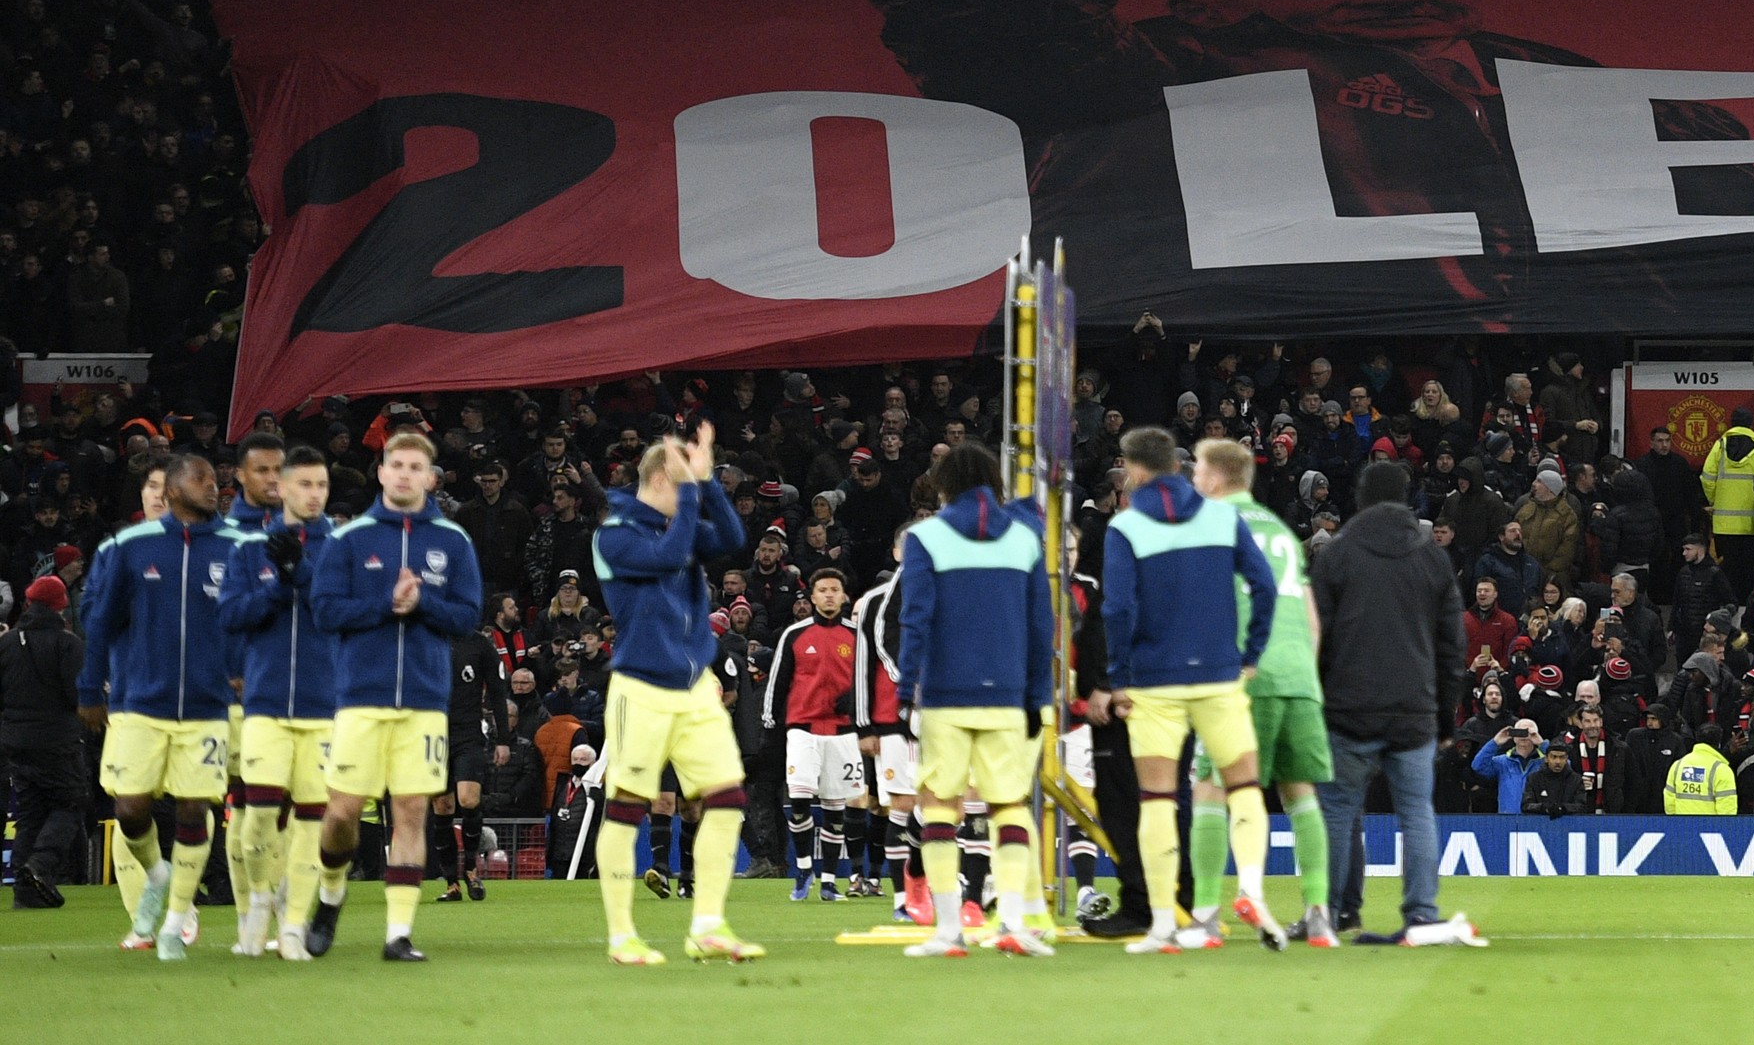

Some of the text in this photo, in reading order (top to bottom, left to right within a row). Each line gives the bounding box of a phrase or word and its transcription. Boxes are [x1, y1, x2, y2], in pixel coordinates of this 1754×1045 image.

[1336, 88, 1435, 120] OGS
[66, 365, 114, 378] W106
[1674, 371, 1719, 385] W105
[1673, 398, 1722, 418] MANCHESTER
[1680, 440, 1714, 453] UNITED
[424, 734, 446, 763] 10
[843, 762, 863, 781] 25
[1682, 782, 1702, 794] 264
